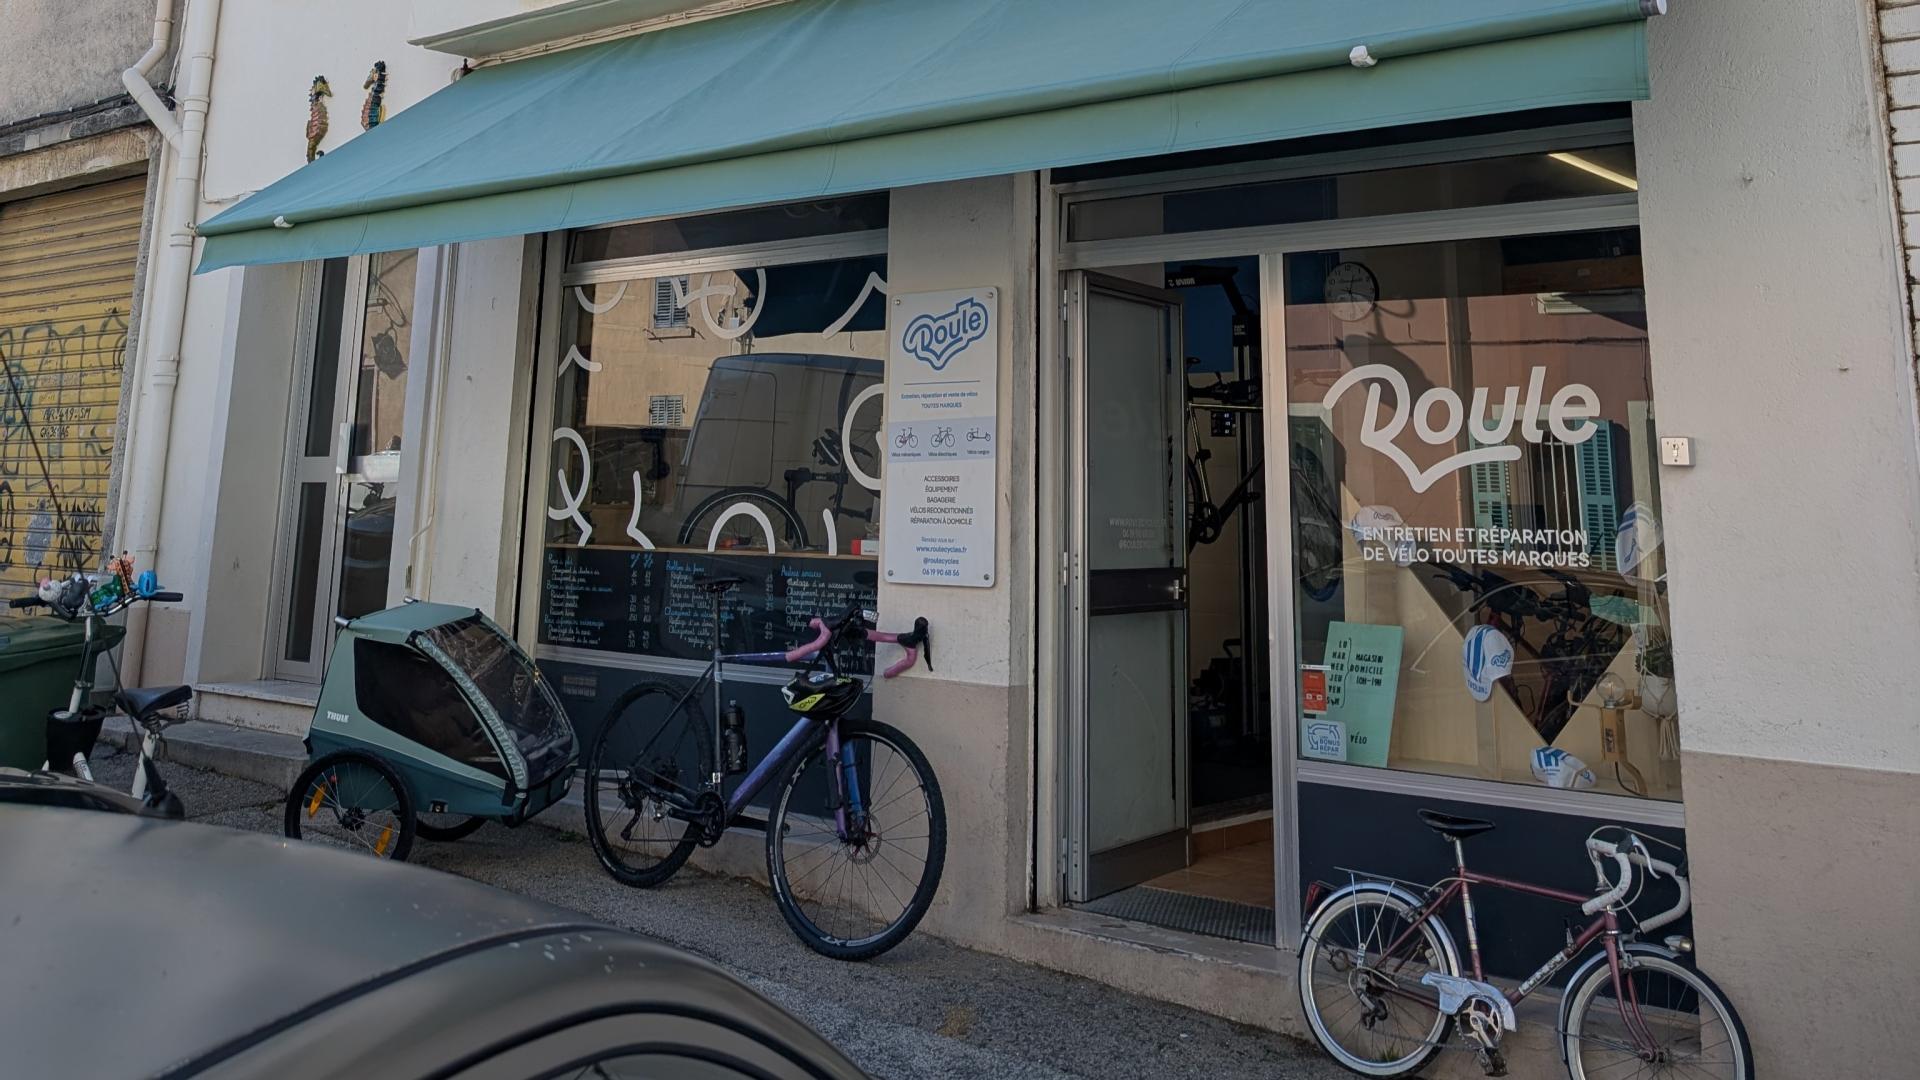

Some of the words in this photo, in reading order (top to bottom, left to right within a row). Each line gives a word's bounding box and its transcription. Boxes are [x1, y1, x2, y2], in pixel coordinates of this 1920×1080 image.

[909, 309, 981, 361] Roule
[1323, 364, 1600, 493] Roule
[925, 484, 958, 492] ÉQUIPEMENT
[910, 505, 926, 513] VÉLOS
[927, 506, 974, 514] RECONDITIONNÉS
[910, 516, 942, 524] RÉPARATION
[1363, 527, 1450, 542] ENTRETIEN
[1456, 528, 1475, 542] ET
[1478, 526, 1588, 546] RÉPARATION
[916, 546, 967, 554] www.roulecycles.fr
[1363, 547, 1384, 561] DE
[1388, 543, 1430, 563] VÉLO
[1432, 549, 1498, 564] TOUTES
[1502, 551, 1590, 568] MARQUES
[922, 568, 929, 576] 06
[1350, 664, 1383, 675] DOMICILE
[1329, 674, 1342, 682] JEU
[327, 710, 349, 723] THULE
[1350, 731, 1368, 745] VÉLO
